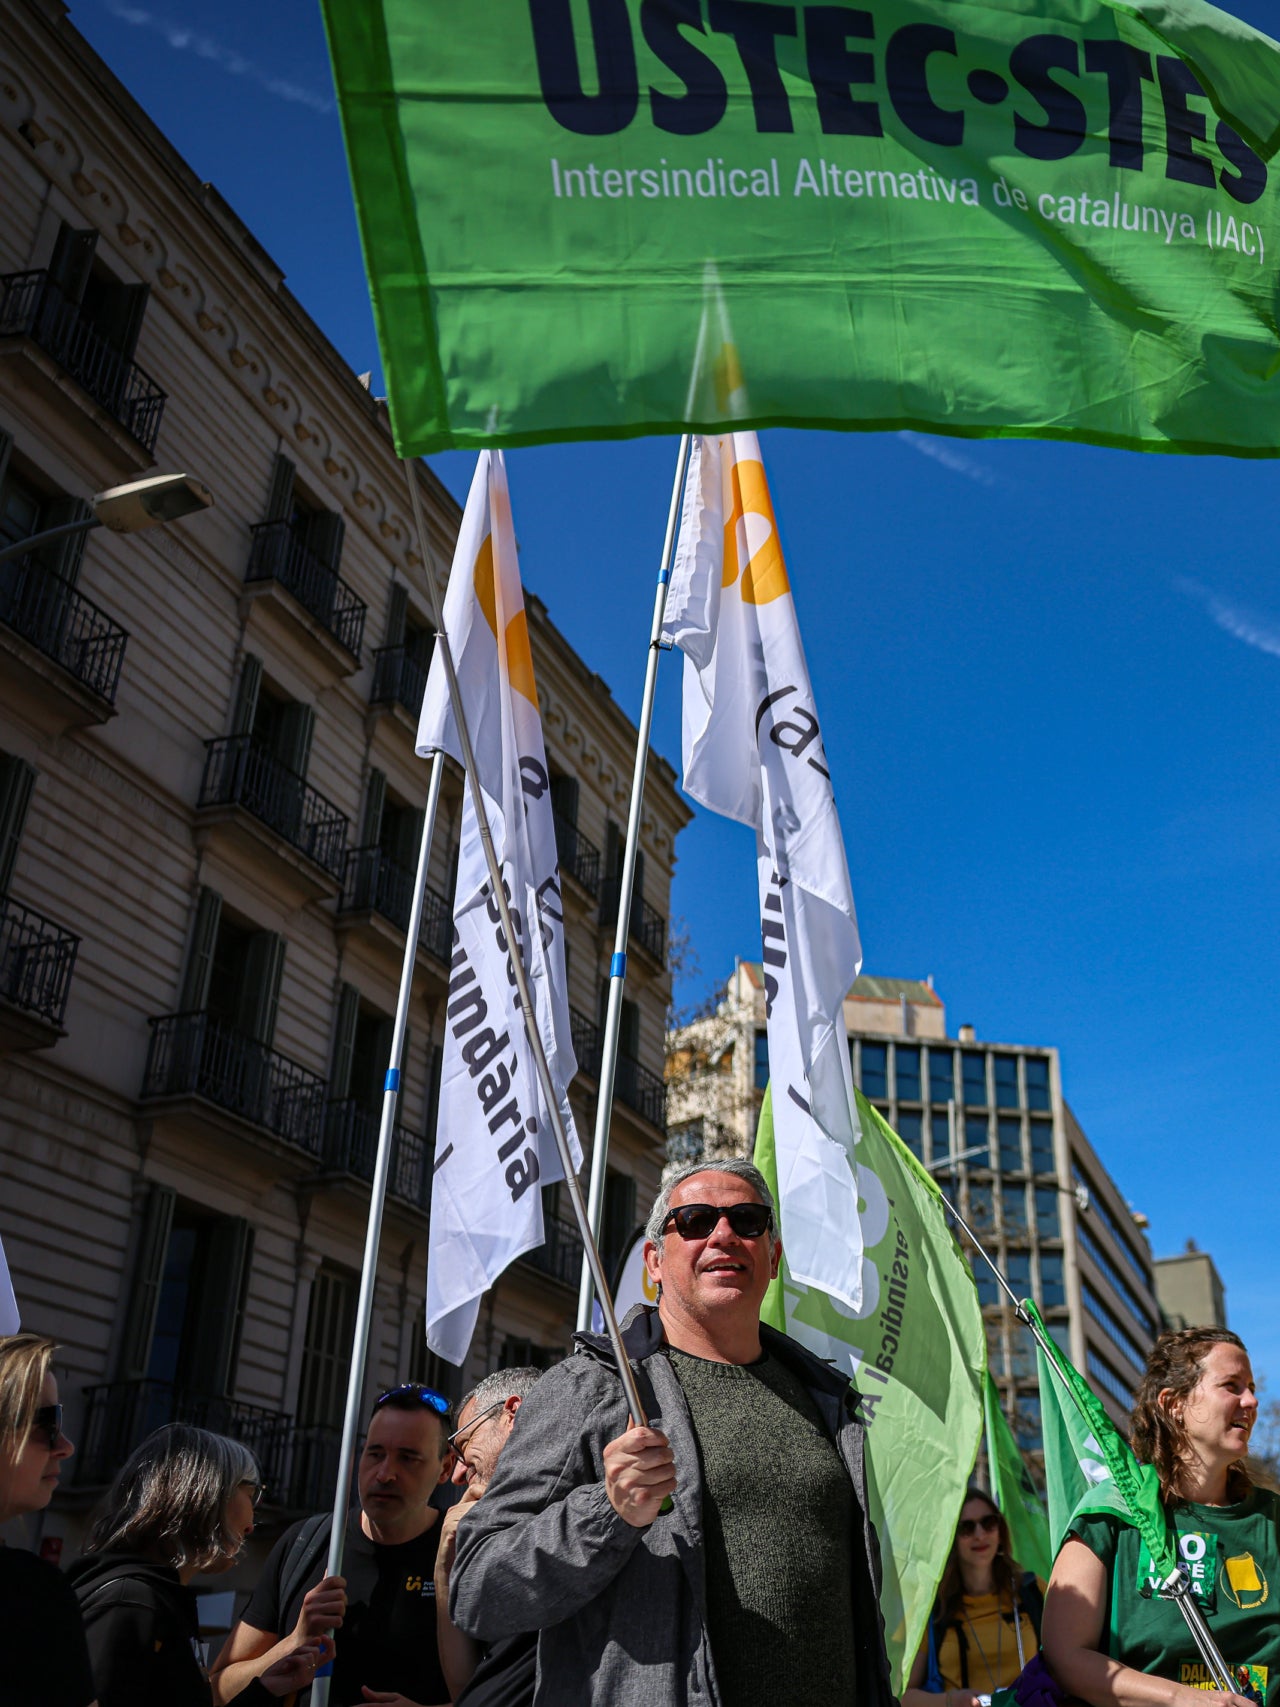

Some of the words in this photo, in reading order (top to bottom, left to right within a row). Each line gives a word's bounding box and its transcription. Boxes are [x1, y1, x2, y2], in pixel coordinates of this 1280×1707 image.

[549, 157, 780, 199] Intersindical
[793, 157, 980, 207] Alternativa
[992, 175, 1030, 212] de
[1205, 208, 1265, 266] (IAC)
